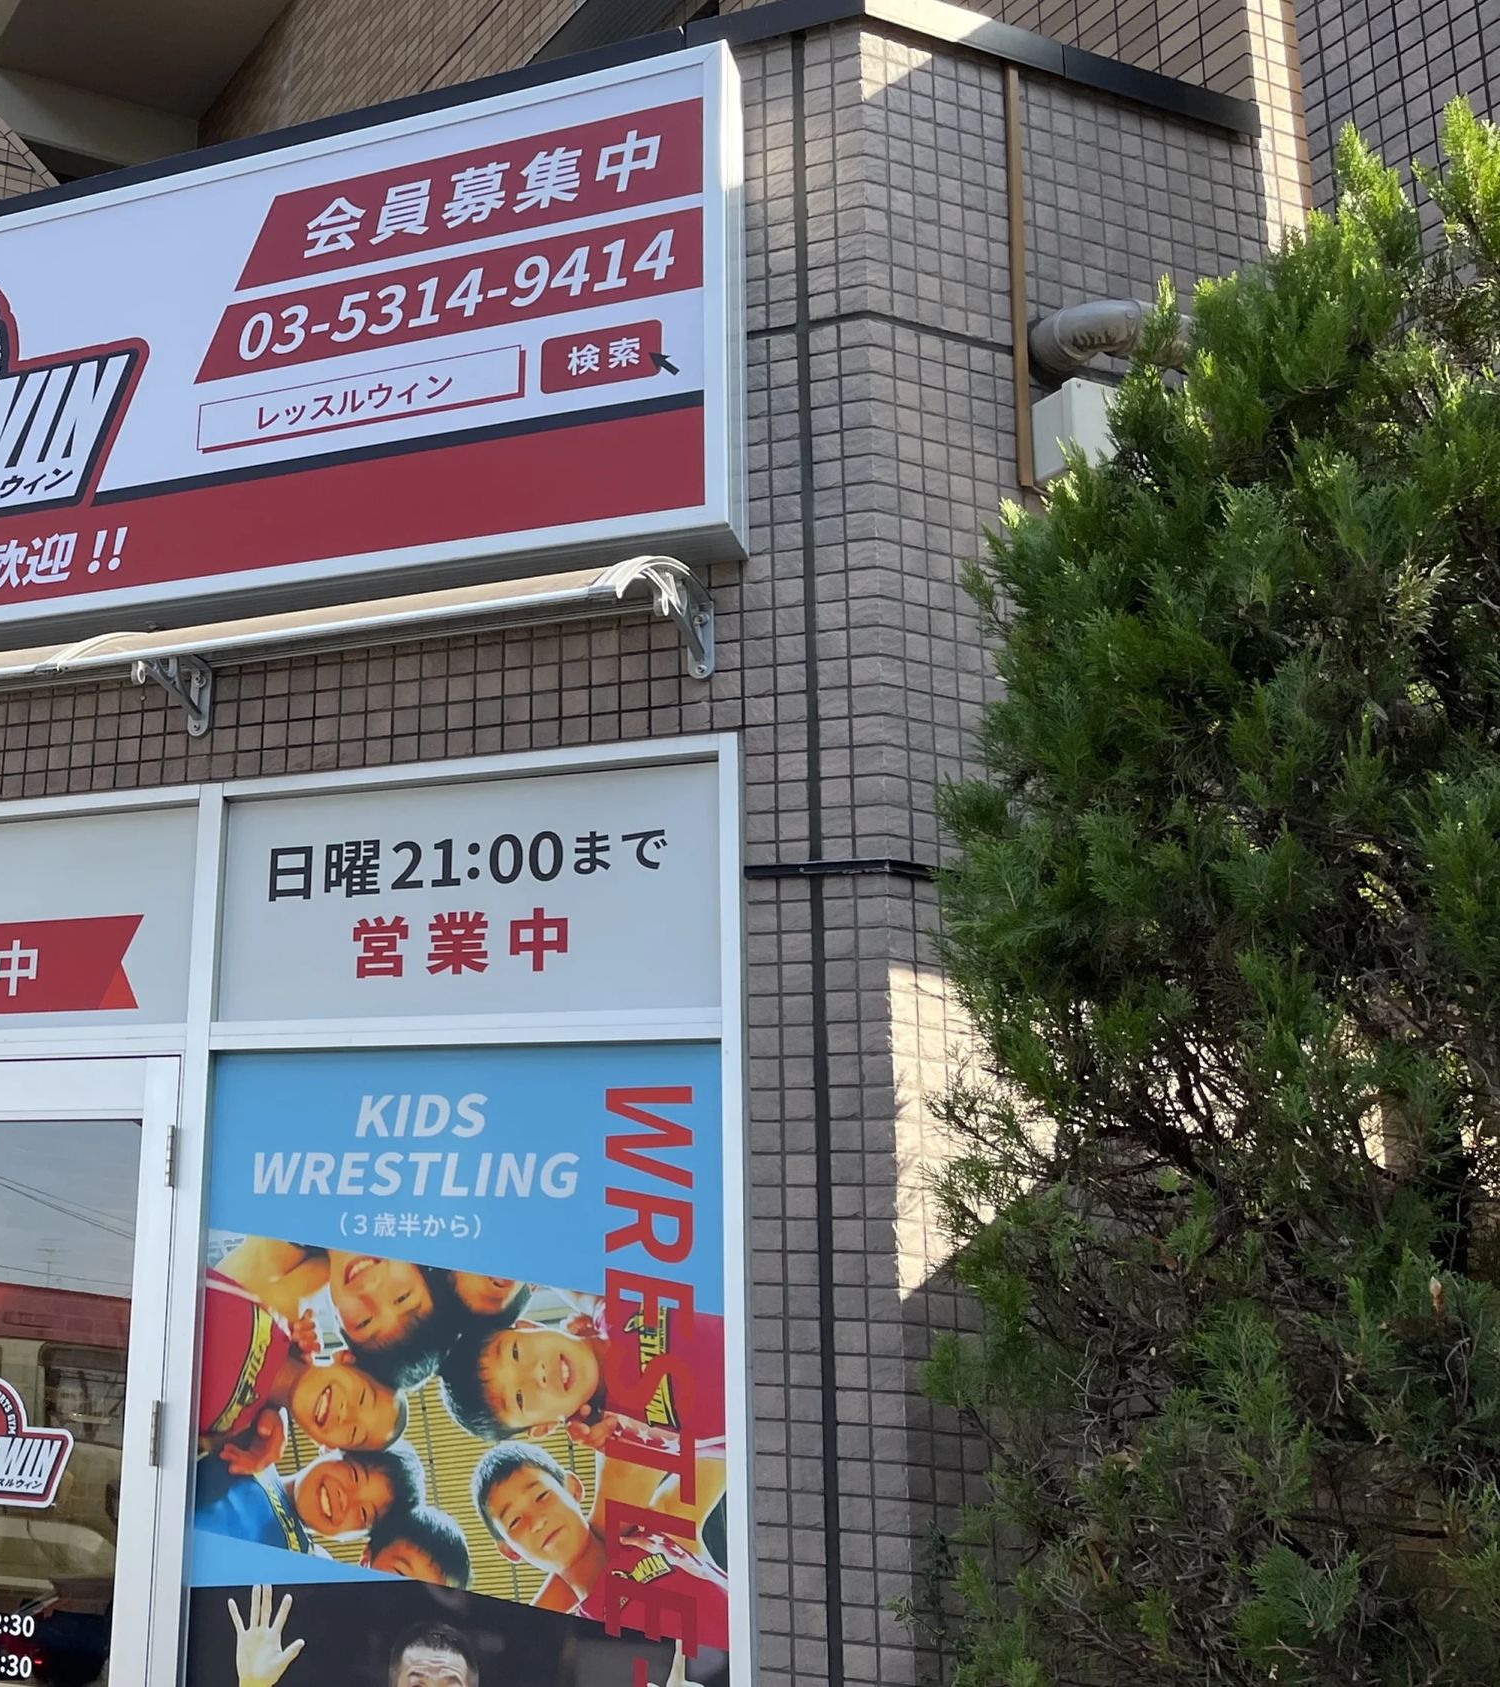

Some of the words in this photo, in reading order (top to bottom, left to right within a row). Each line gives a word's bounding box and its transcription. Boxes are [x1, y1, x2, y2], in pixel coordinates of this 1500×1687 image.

[304, 130, 662, 259] 会員募集中
[238, 229, 676, 362] 03-5314-9414
[567, 337, 642, 377] 検索
[257, 374, 453, 431] レッスルウィン
[267, 828, 668, 902] 日曜21:00まで
[352, 907, 569, 979] 営業中
[355, 1092, 488, 1138] KIDS
[253, 1150, 580, 1199] WRESTLING
